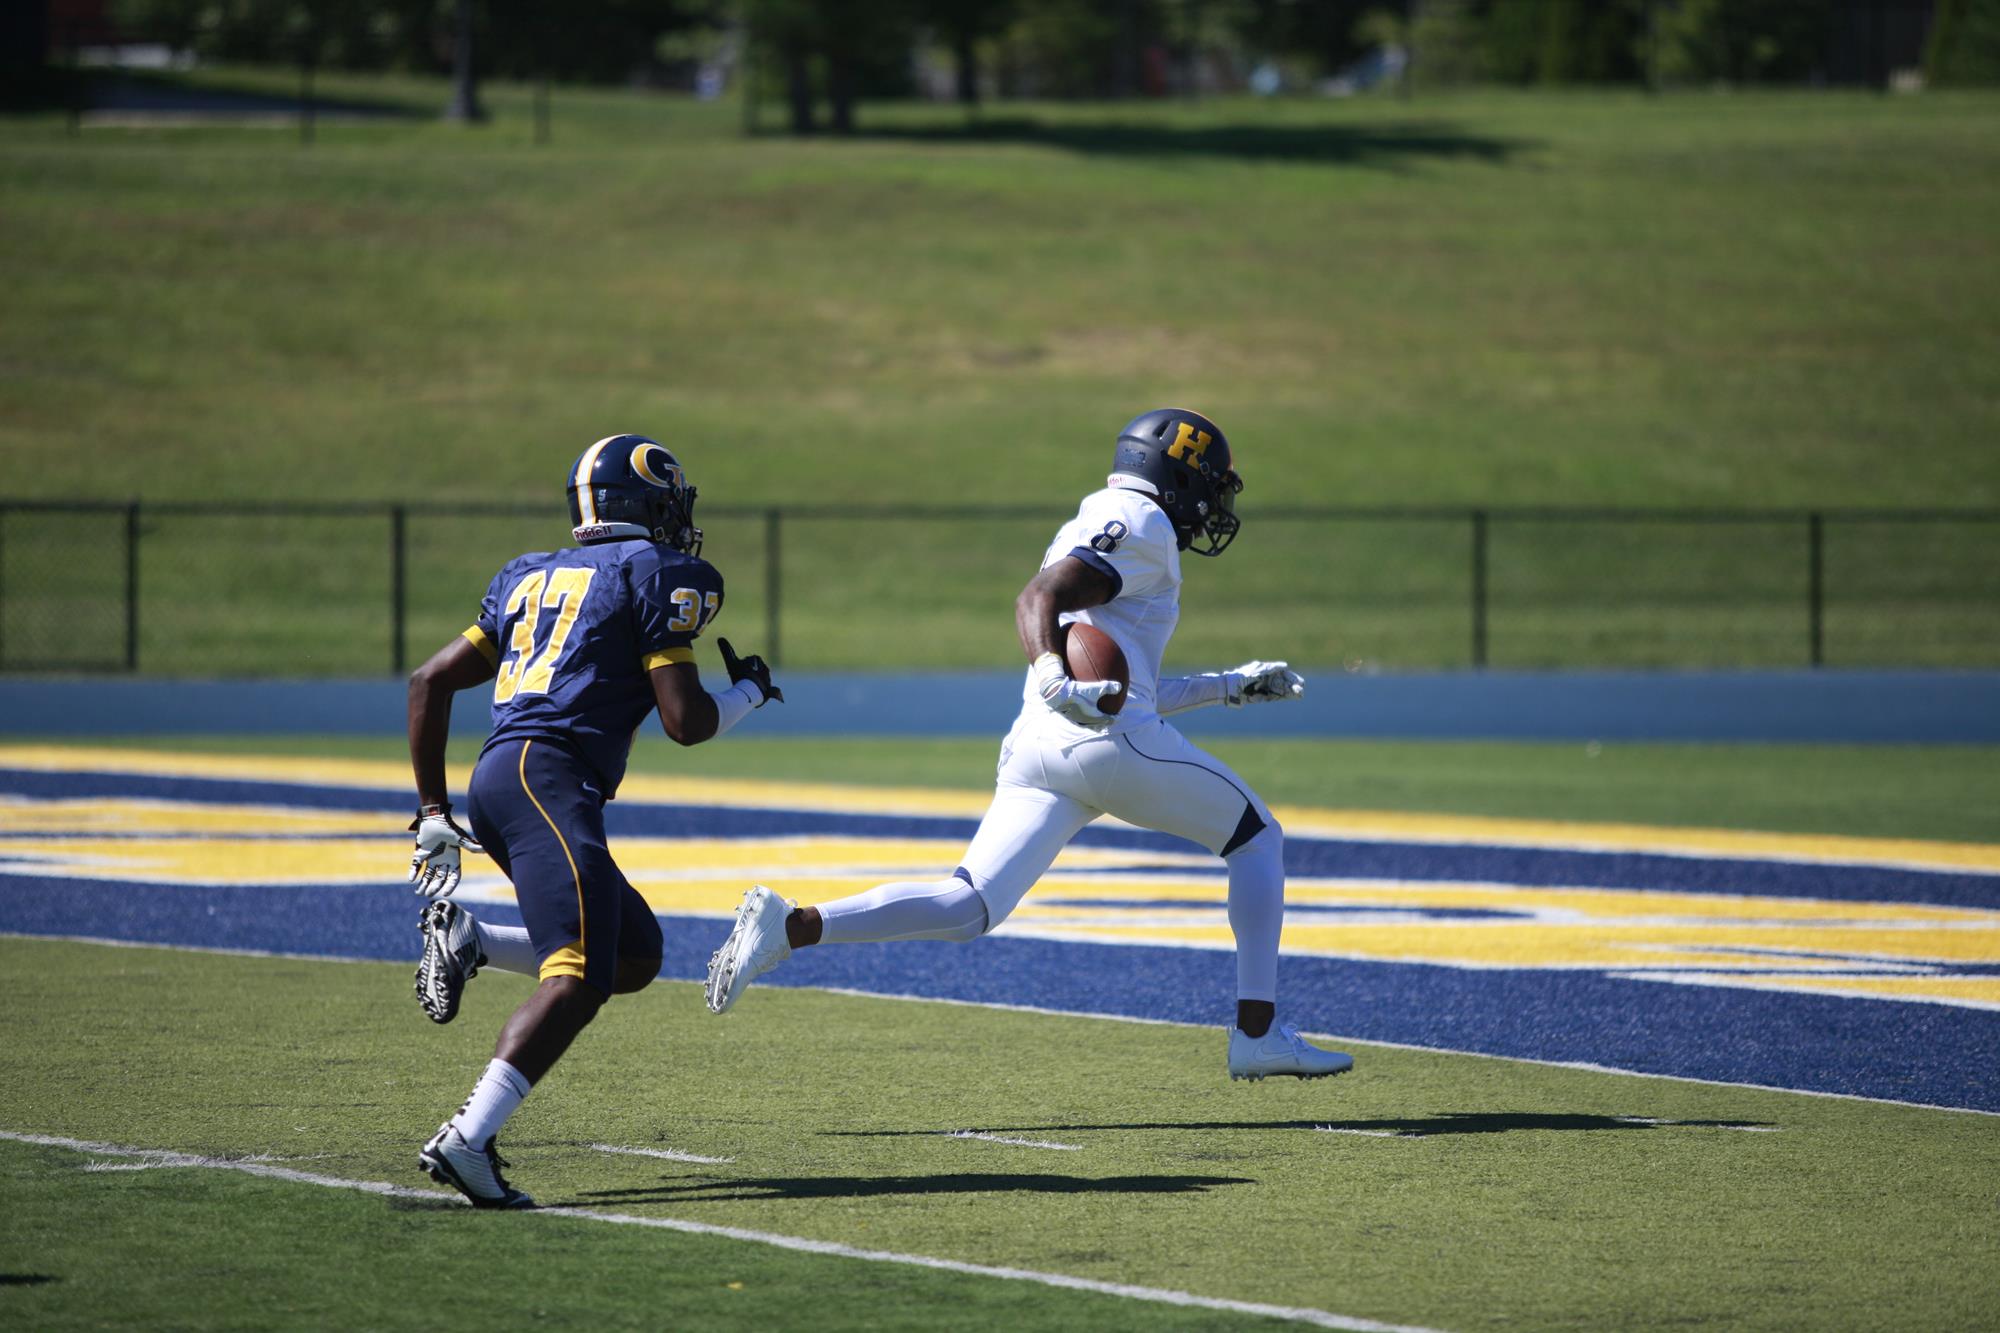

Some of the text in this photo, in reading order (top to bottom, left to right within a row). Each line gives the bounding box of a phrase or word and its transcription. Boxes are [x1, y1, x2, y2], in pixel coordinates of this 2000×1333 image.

[1167, 422, 1212, 470] H
[574, 526, 612, 541] Riddell
[1089, 520, 1130, 553] 8
[667, 587, 719, 635] 37
[494, 567, 597, 704] 37
